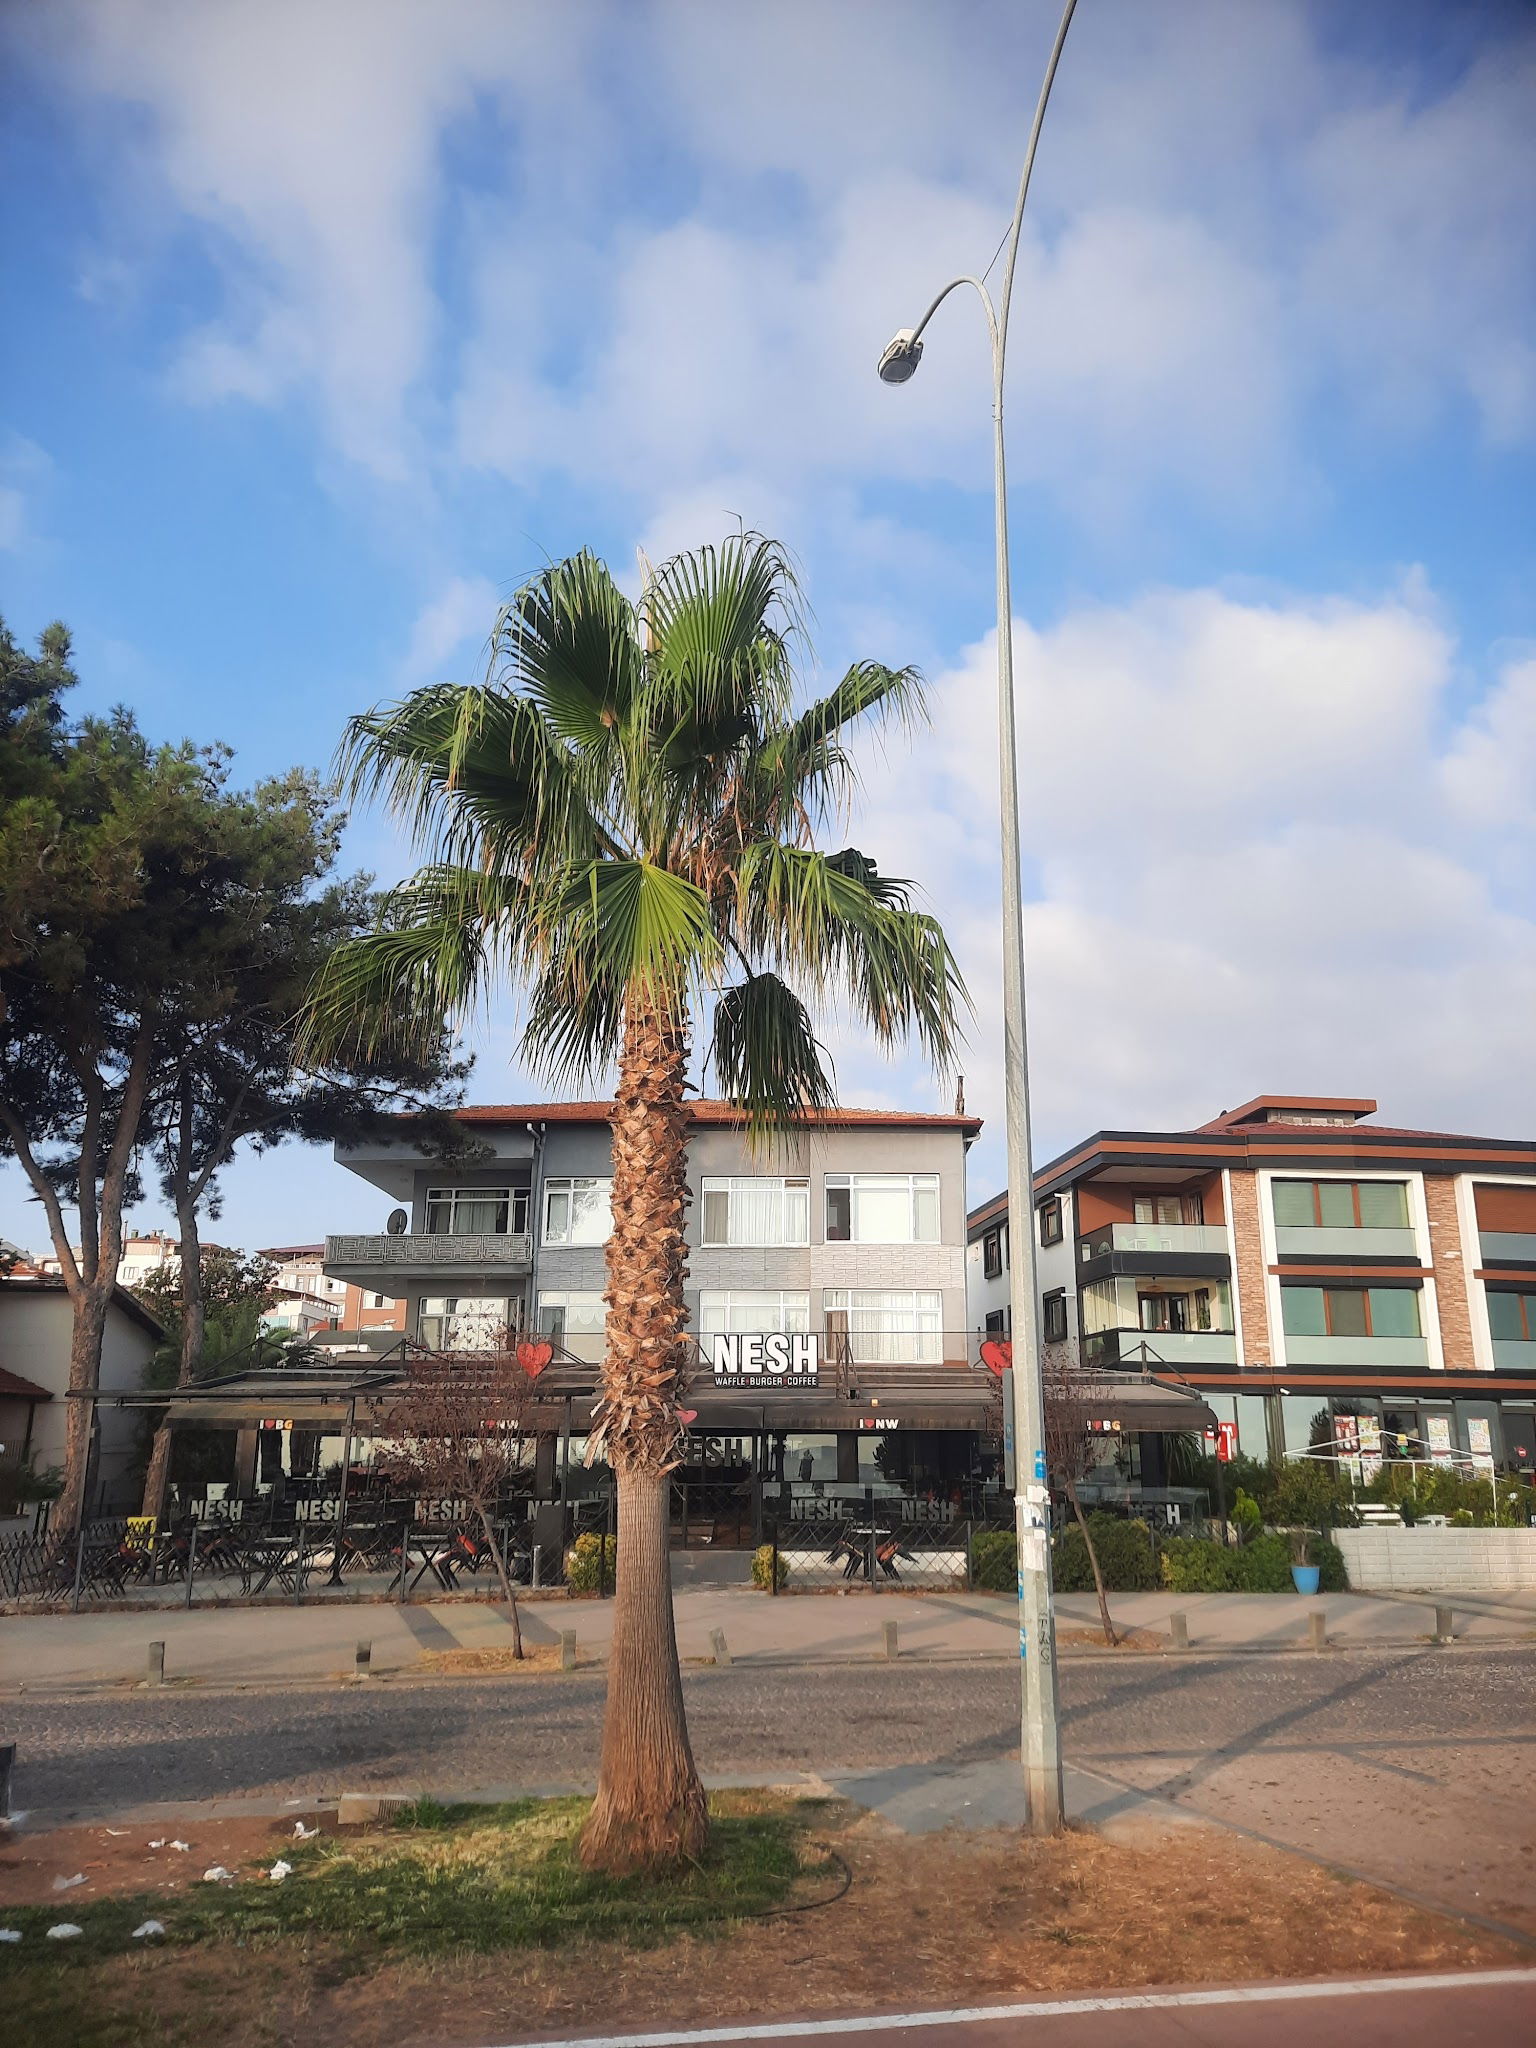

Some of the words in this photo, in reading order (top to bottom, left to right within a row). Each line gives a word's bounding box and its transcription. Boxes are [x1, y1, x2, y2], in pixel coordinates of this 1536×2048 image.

[714, 1333, 818, 1374] NESH
[715, 1377, 745, 1386] WAFFLE
[750, 1377, 782, 1386] BURGER
[787, 1377, 816, 1386] COFFEE
[875, 1418, 899, 1429] NW
[191, 1500, 243, 1521] NESH
[413, 1500, 467, 1521] NESH
[790, 1500, 843, 1520] NESH
[901, 1500, 955, 1522] NESH
